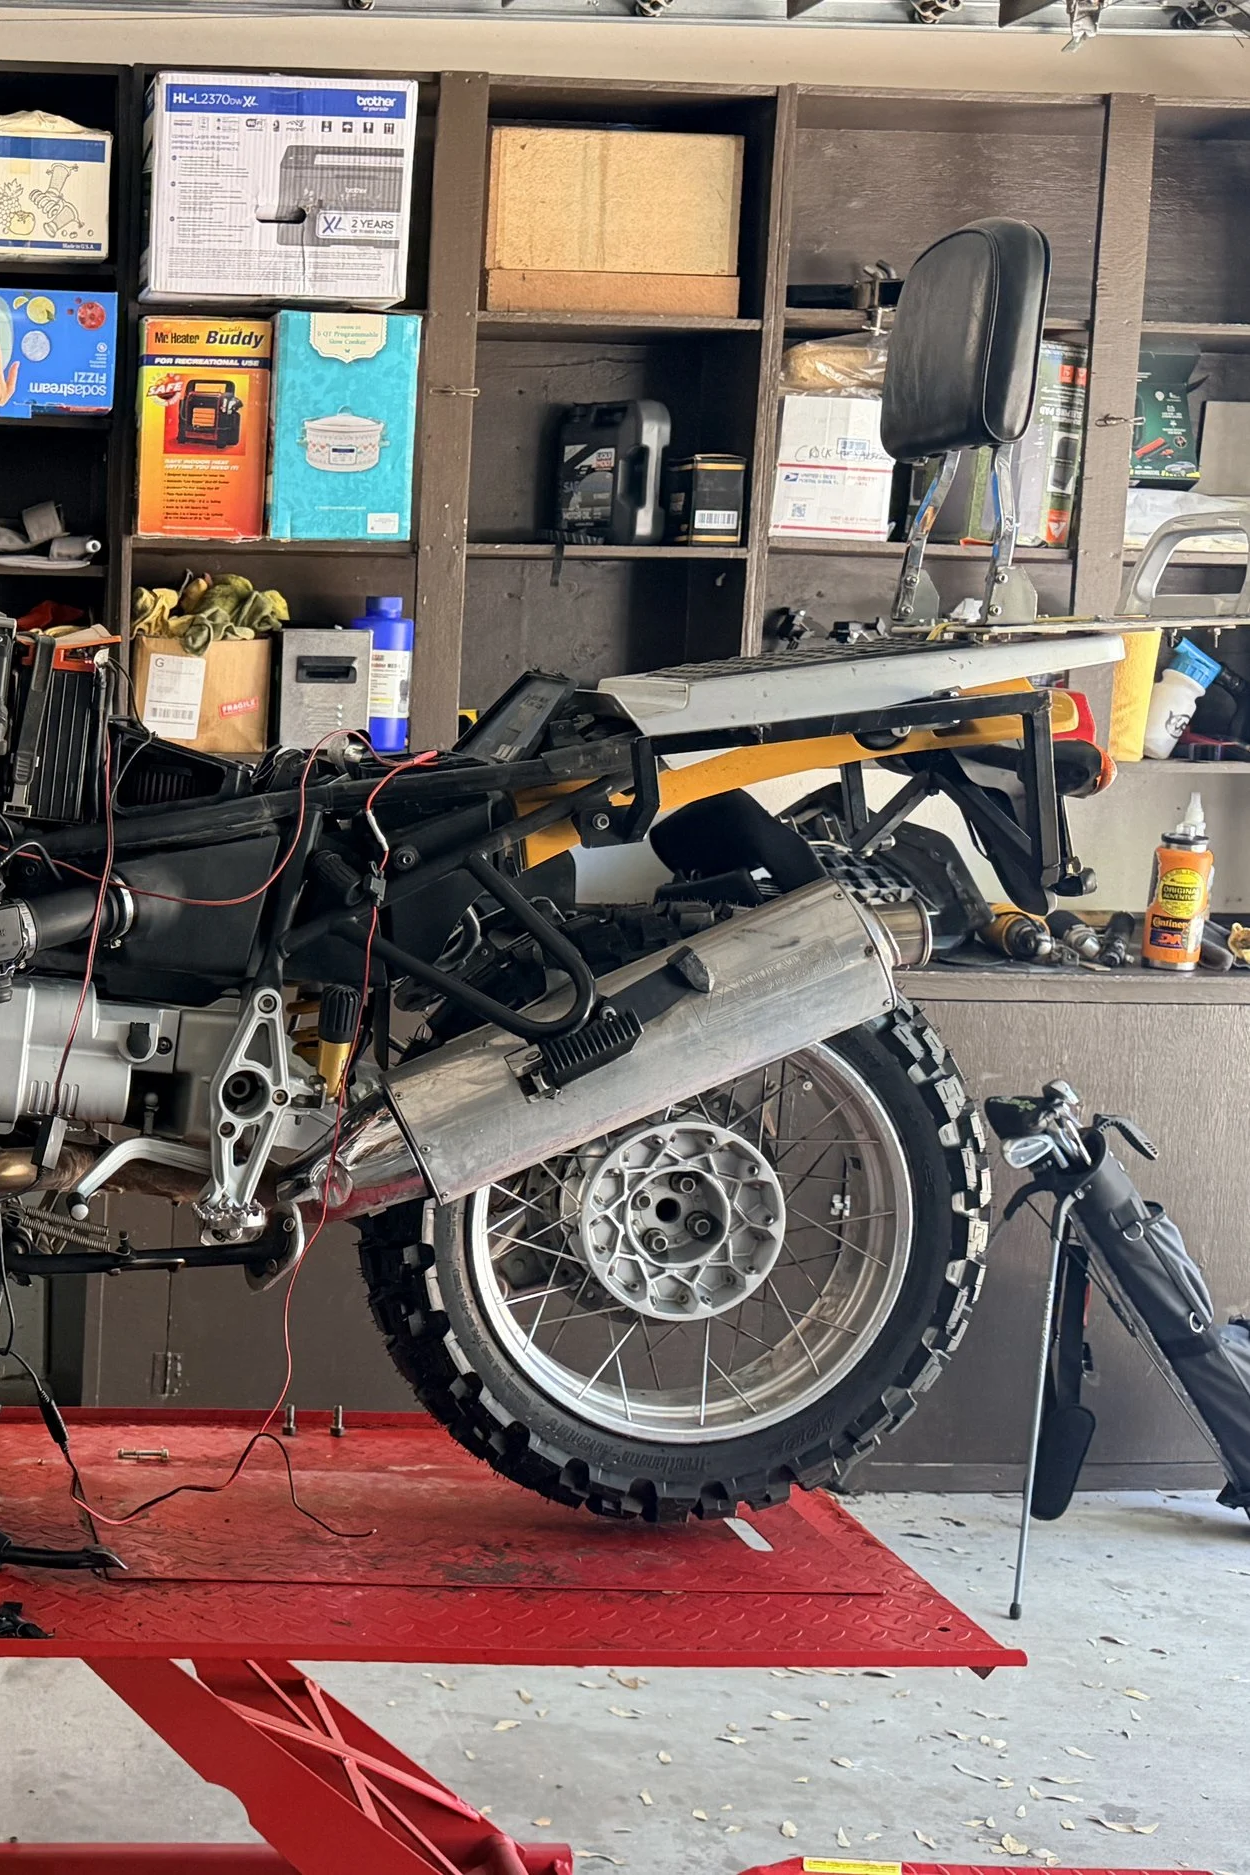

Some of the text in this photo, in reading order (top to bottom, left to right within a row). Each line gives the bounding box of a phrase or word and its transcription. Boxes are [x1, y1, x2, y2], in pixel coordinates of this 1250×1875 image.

[356, 95, 397, 107] brother
[321, 215, 347, 234] XL
[351, 219, 394, 229] 2 YEARS
[170, 332, 200, 344] Heater
[205, 330, 265, 349] Buddy
[154, 357, 173, 365] FOR
[174, 358, 240, 366] RECREATIONAL
[74, 371, 107, 384] FIZZI
[29, 382, 107, 398] sodastream
[147, 381, 184, 396] SAFE
[1039, 405, 1055, 416] PAD
[155, 658, 164, 668] G
[222, 699, 256, 713] FRAGILE
[1163, 886, 1199, 896] ORIGINA
